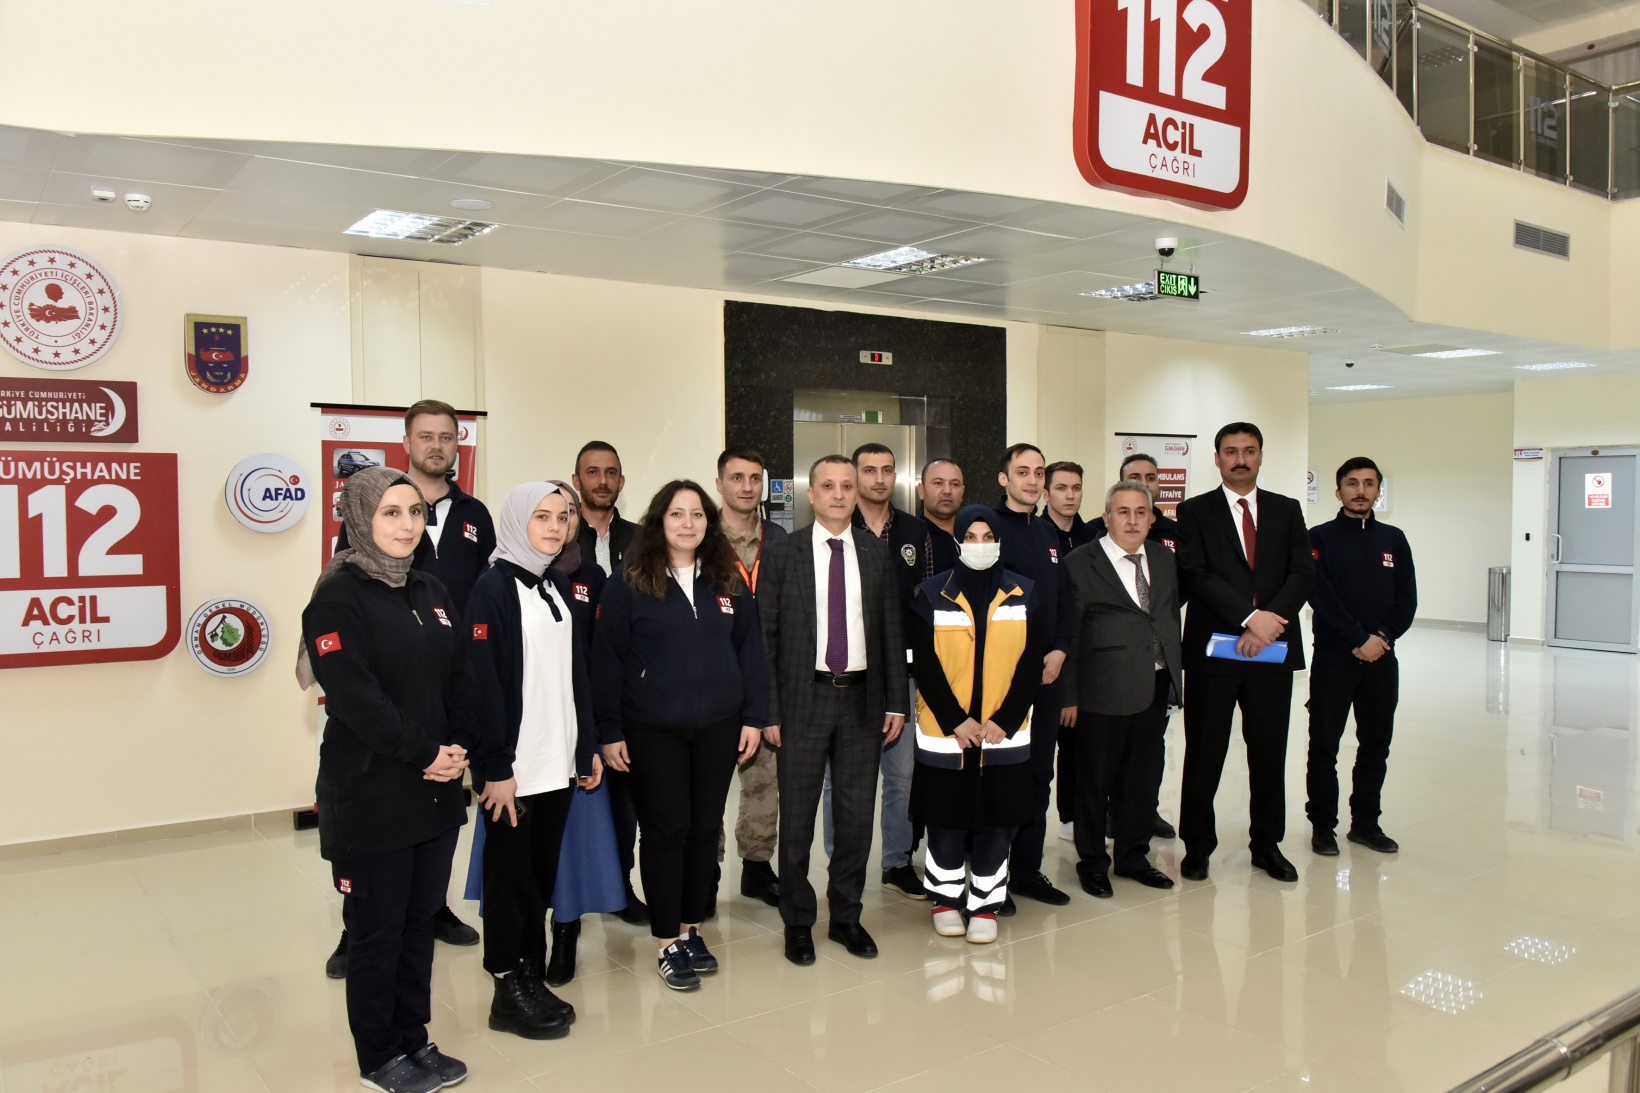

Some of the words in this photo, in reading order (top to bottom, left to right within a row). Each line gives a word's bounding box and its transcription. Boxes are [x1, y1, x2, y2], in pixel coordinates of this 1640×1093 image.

[1118, 0, 1227, 110] 112
[1149, 153, 1196, 178] ÇAĞRI
[1160, 273, 1177, 285] EXIT
[190, 371, 246, 393] JANDARMA
[0, 456, 141, 484] ÜMÜŞHANE
[1157, 472, 1185, 481] MBULANS
[261, 487, 306, 502] AFAD
[466, 523, 478, 536] 112
[1164, 539, 1175, 548] 112
[1383, 553, 1393, 562] 112
[575, 584, 588, 596] 112
[719, 597, 732, 607] 112
[193, 622, 203, 655] ORMAN
[203, 602, 232, 618] GENEL
[32, 627, 101, 650] ÇAĞRI
